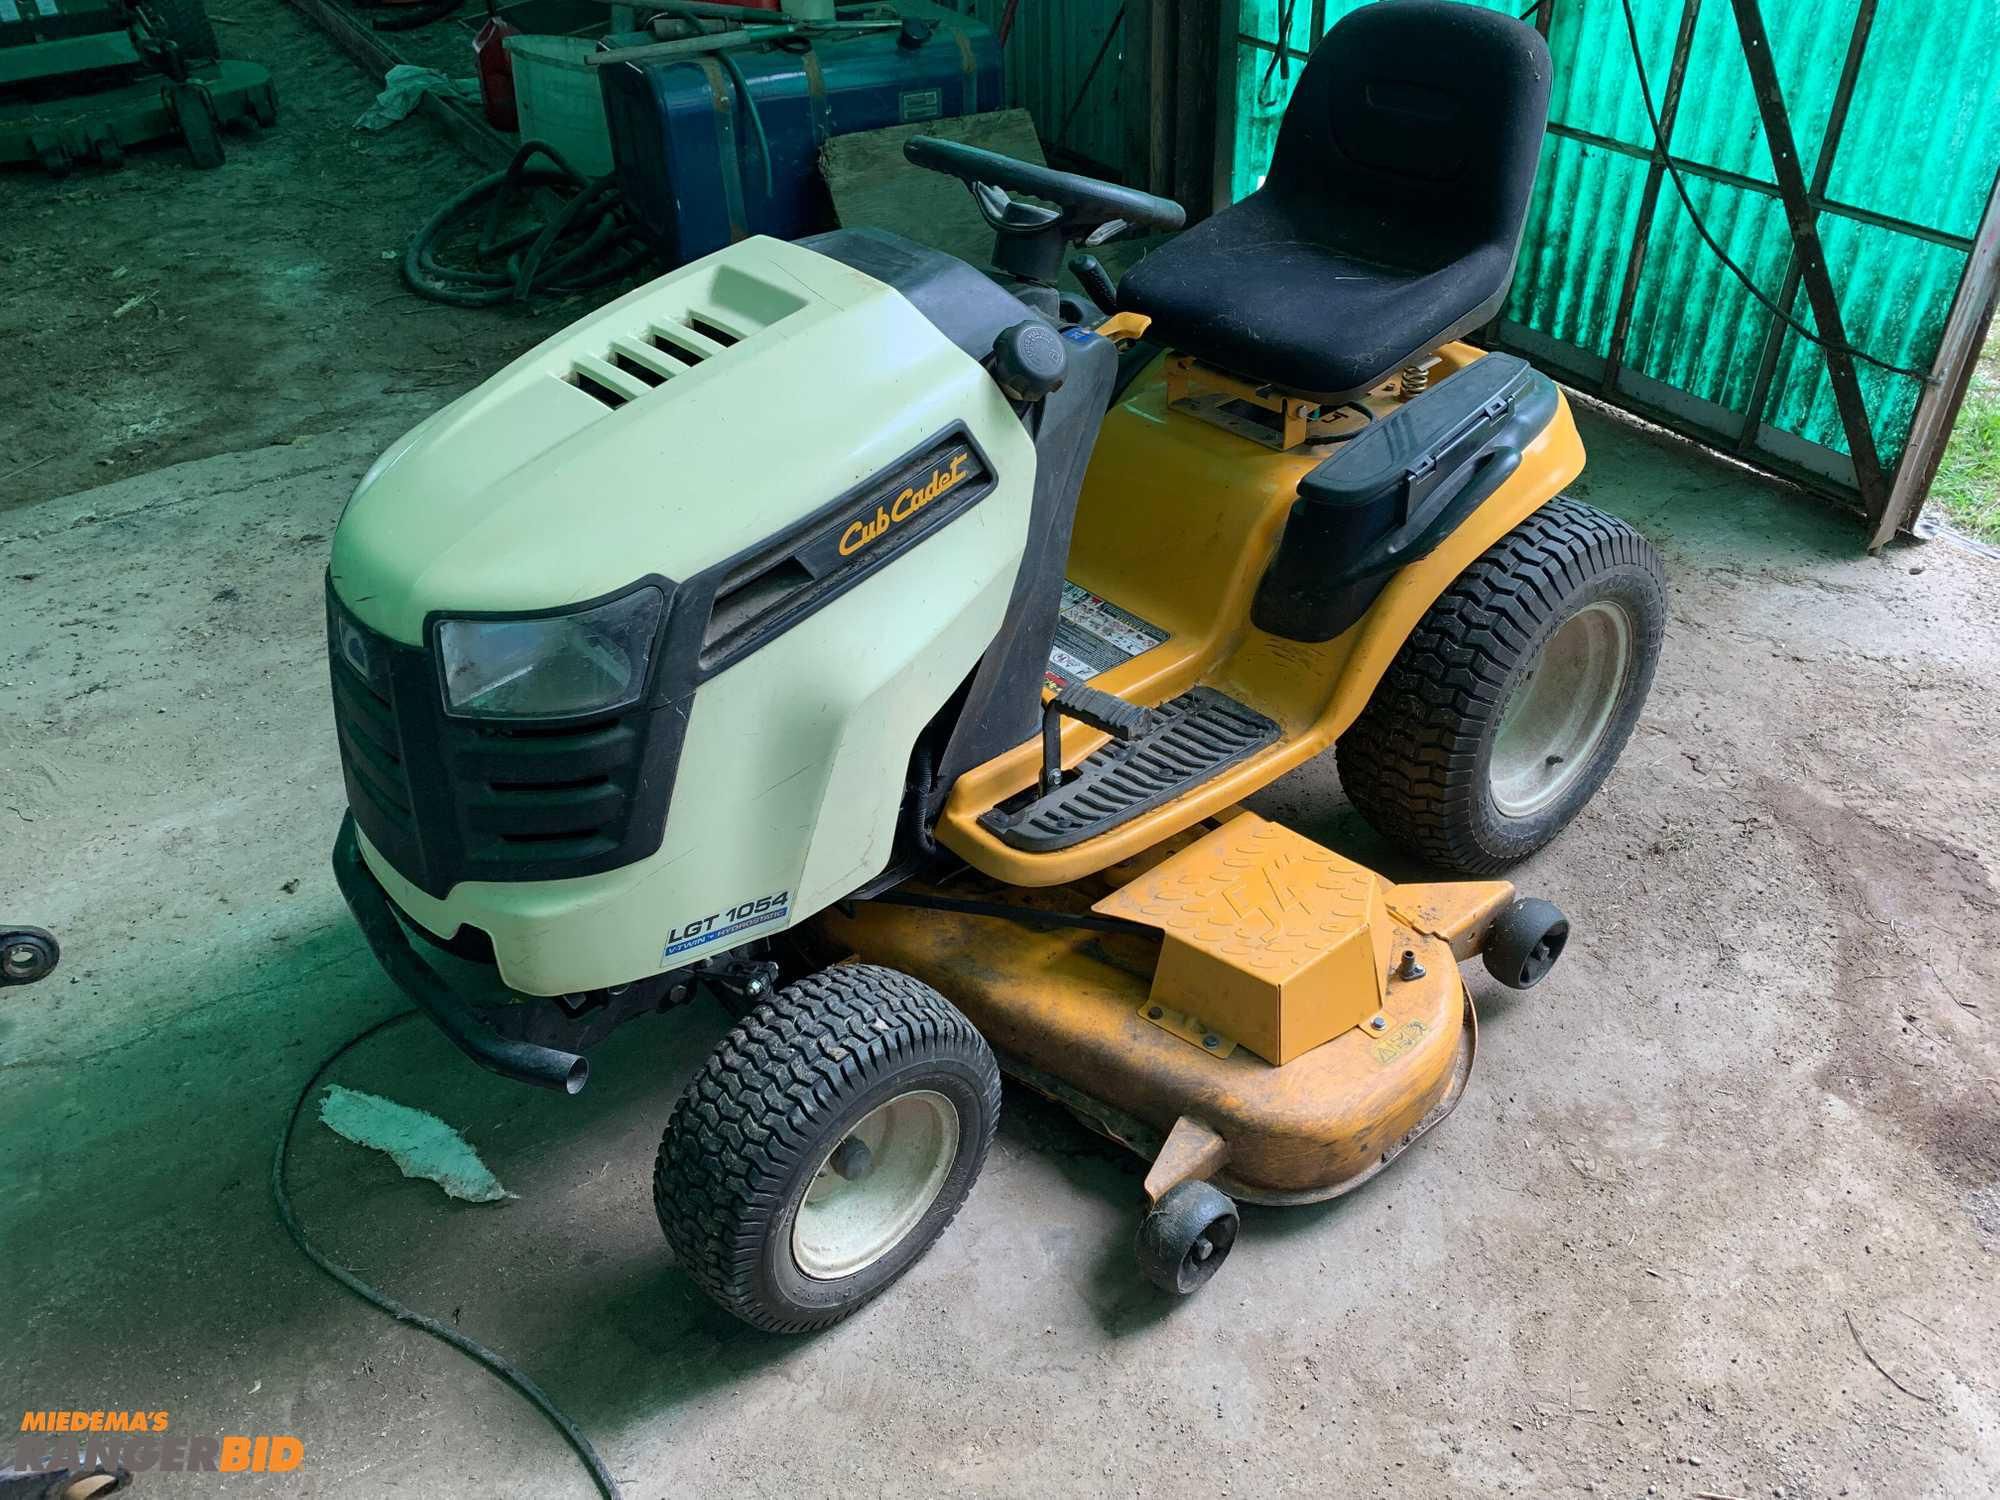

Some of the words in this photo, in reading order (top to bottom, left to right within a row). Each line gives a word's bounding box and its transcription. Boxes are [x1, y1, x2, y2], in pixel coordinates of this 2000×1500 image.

[839, 507, 890, 556] Cub
[891, 453, 968, 523] Cadet
[668, 914, 721, 944] LGT
[726, 891, 789, 922] 1054
